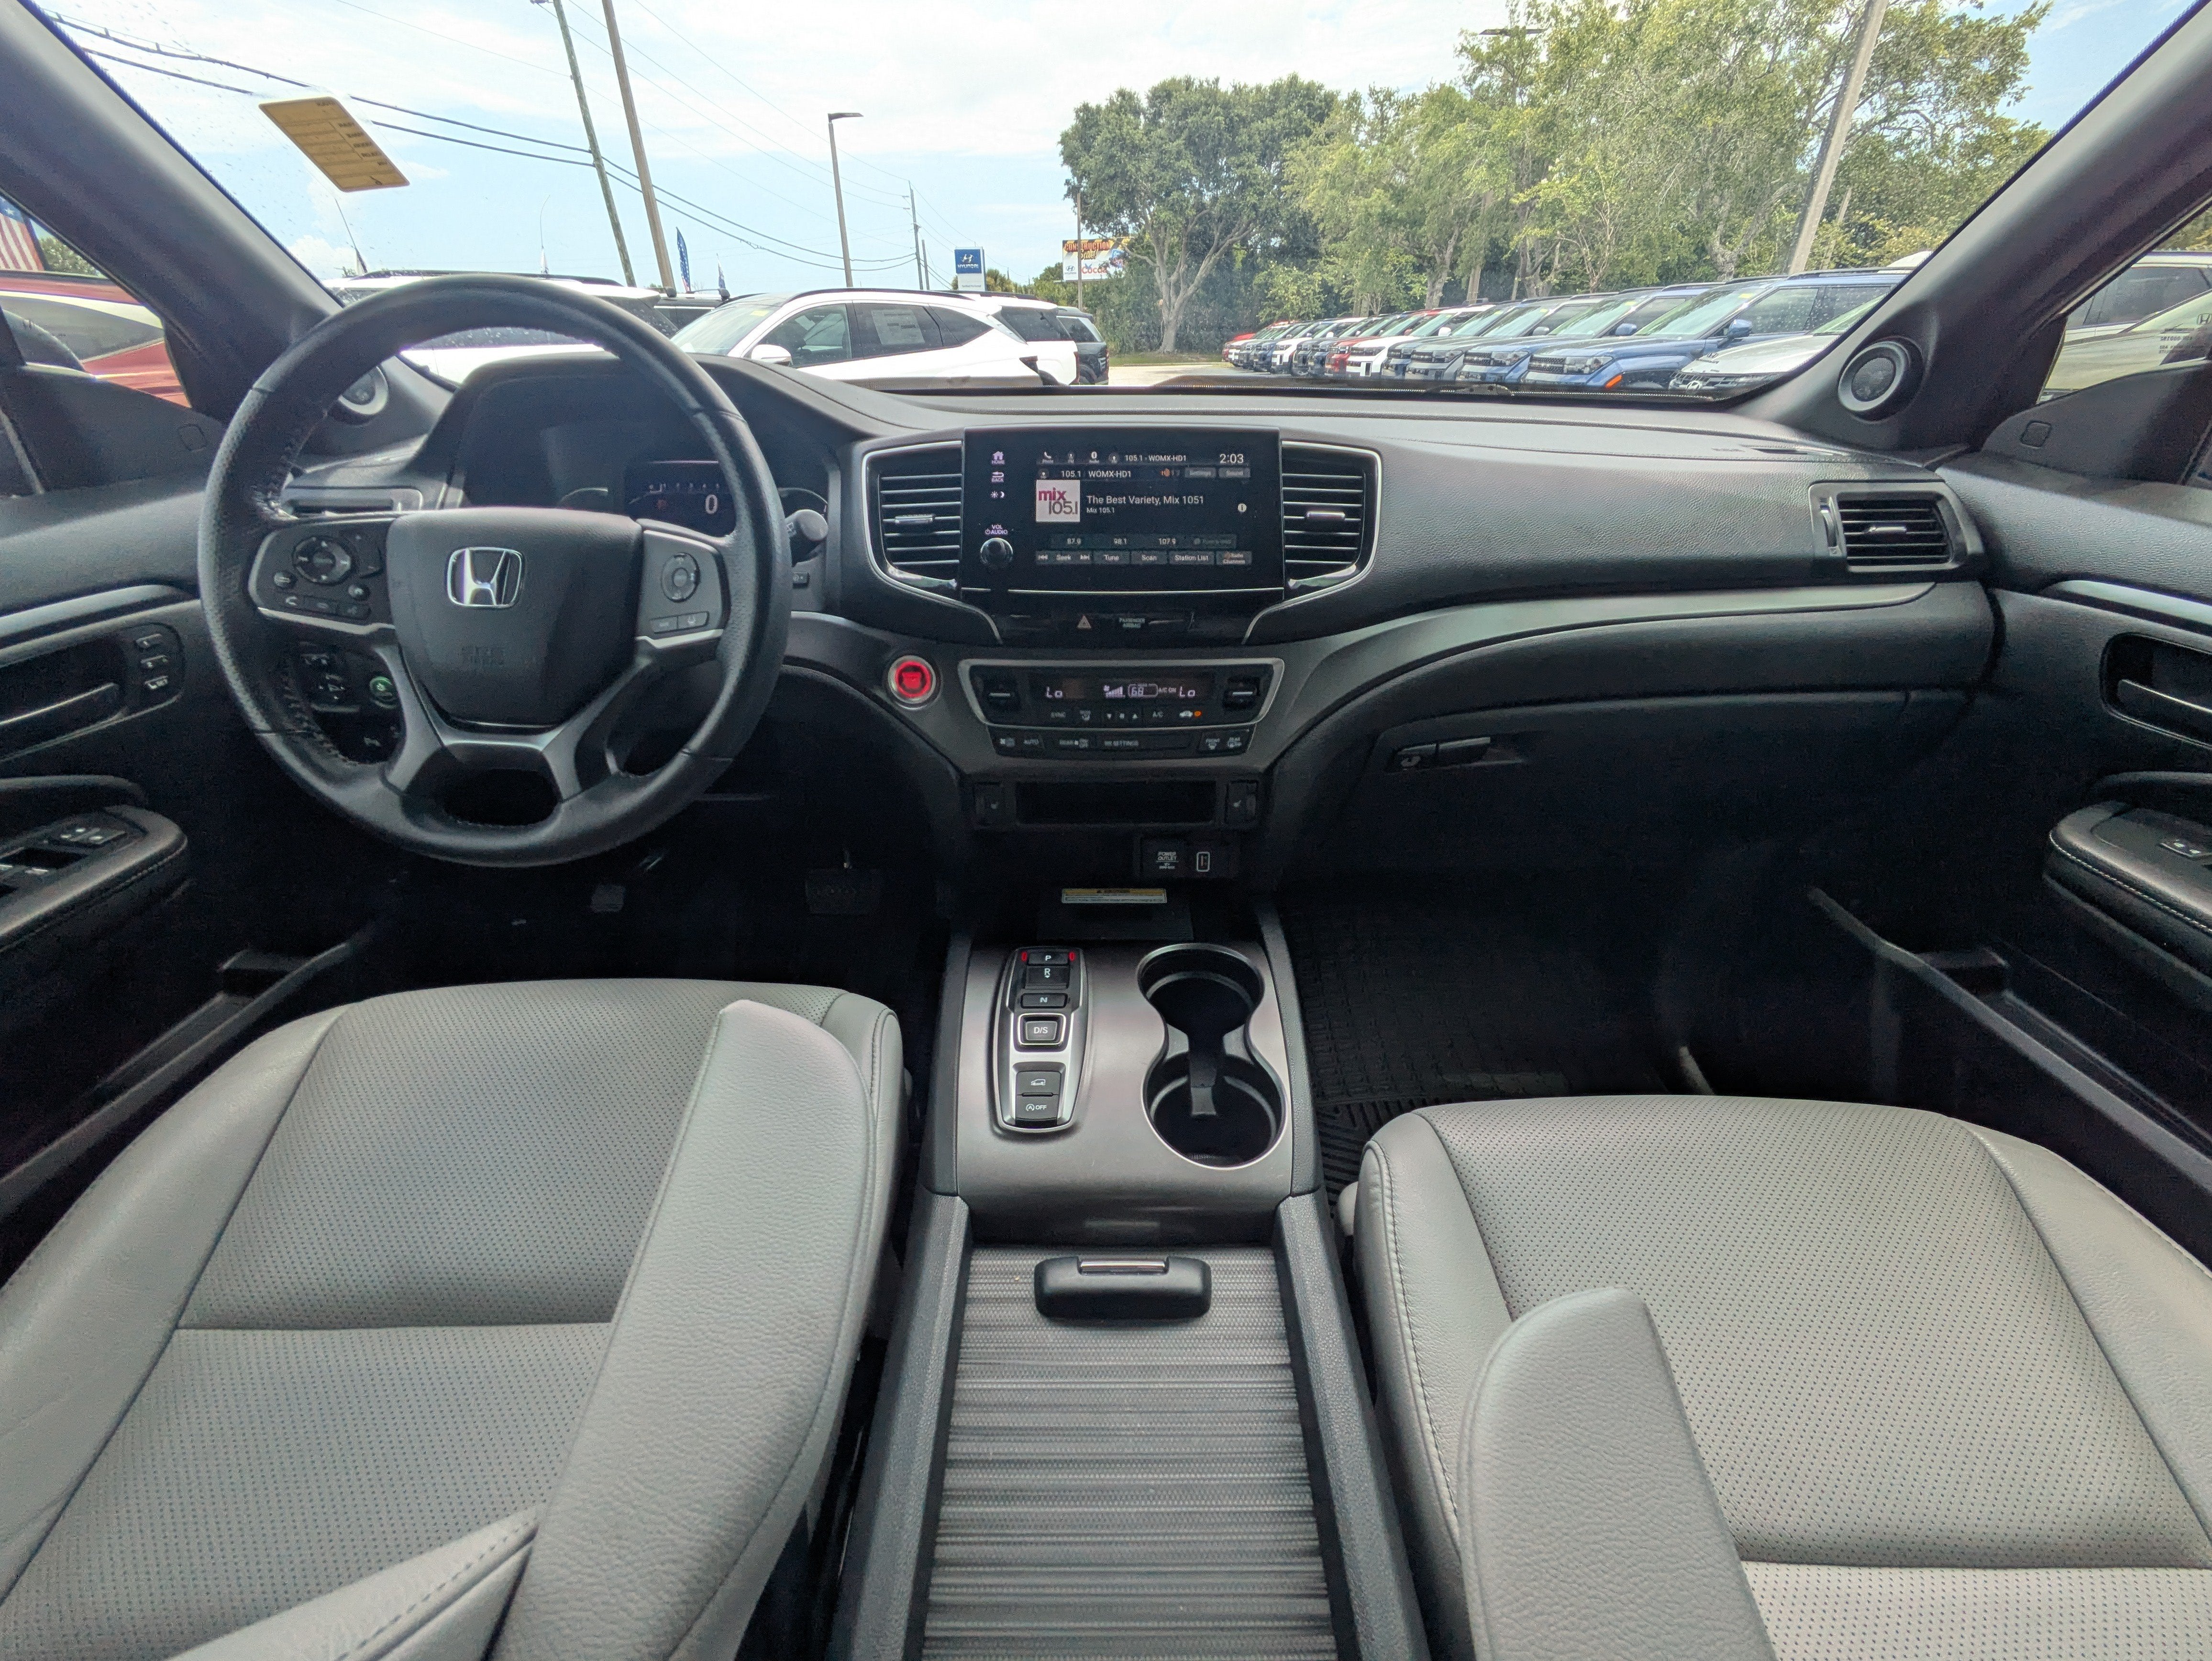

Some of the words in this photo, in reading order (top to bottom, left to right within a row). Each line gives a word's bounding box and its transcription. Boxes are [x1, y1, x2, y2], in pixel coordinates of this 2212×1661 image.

[1220, 454, 1244, 464] 2:03
[1039, 487, 1066, 501] mix
[705, 494, 718, 514] 0
[1086, 496, 1104, 504] The
[1106, 496, 1126, 504] Best
[1128, 496, 1161, 506] Variety,
[1163, 496, 1180, 504] Mix
[1183, 496, 1204, 504] 1051
[1049, 501, 1078, 515] 105.1
[1046, 686, 1063, 698] Lo
[1179, 686, 1196, 697] Lo
